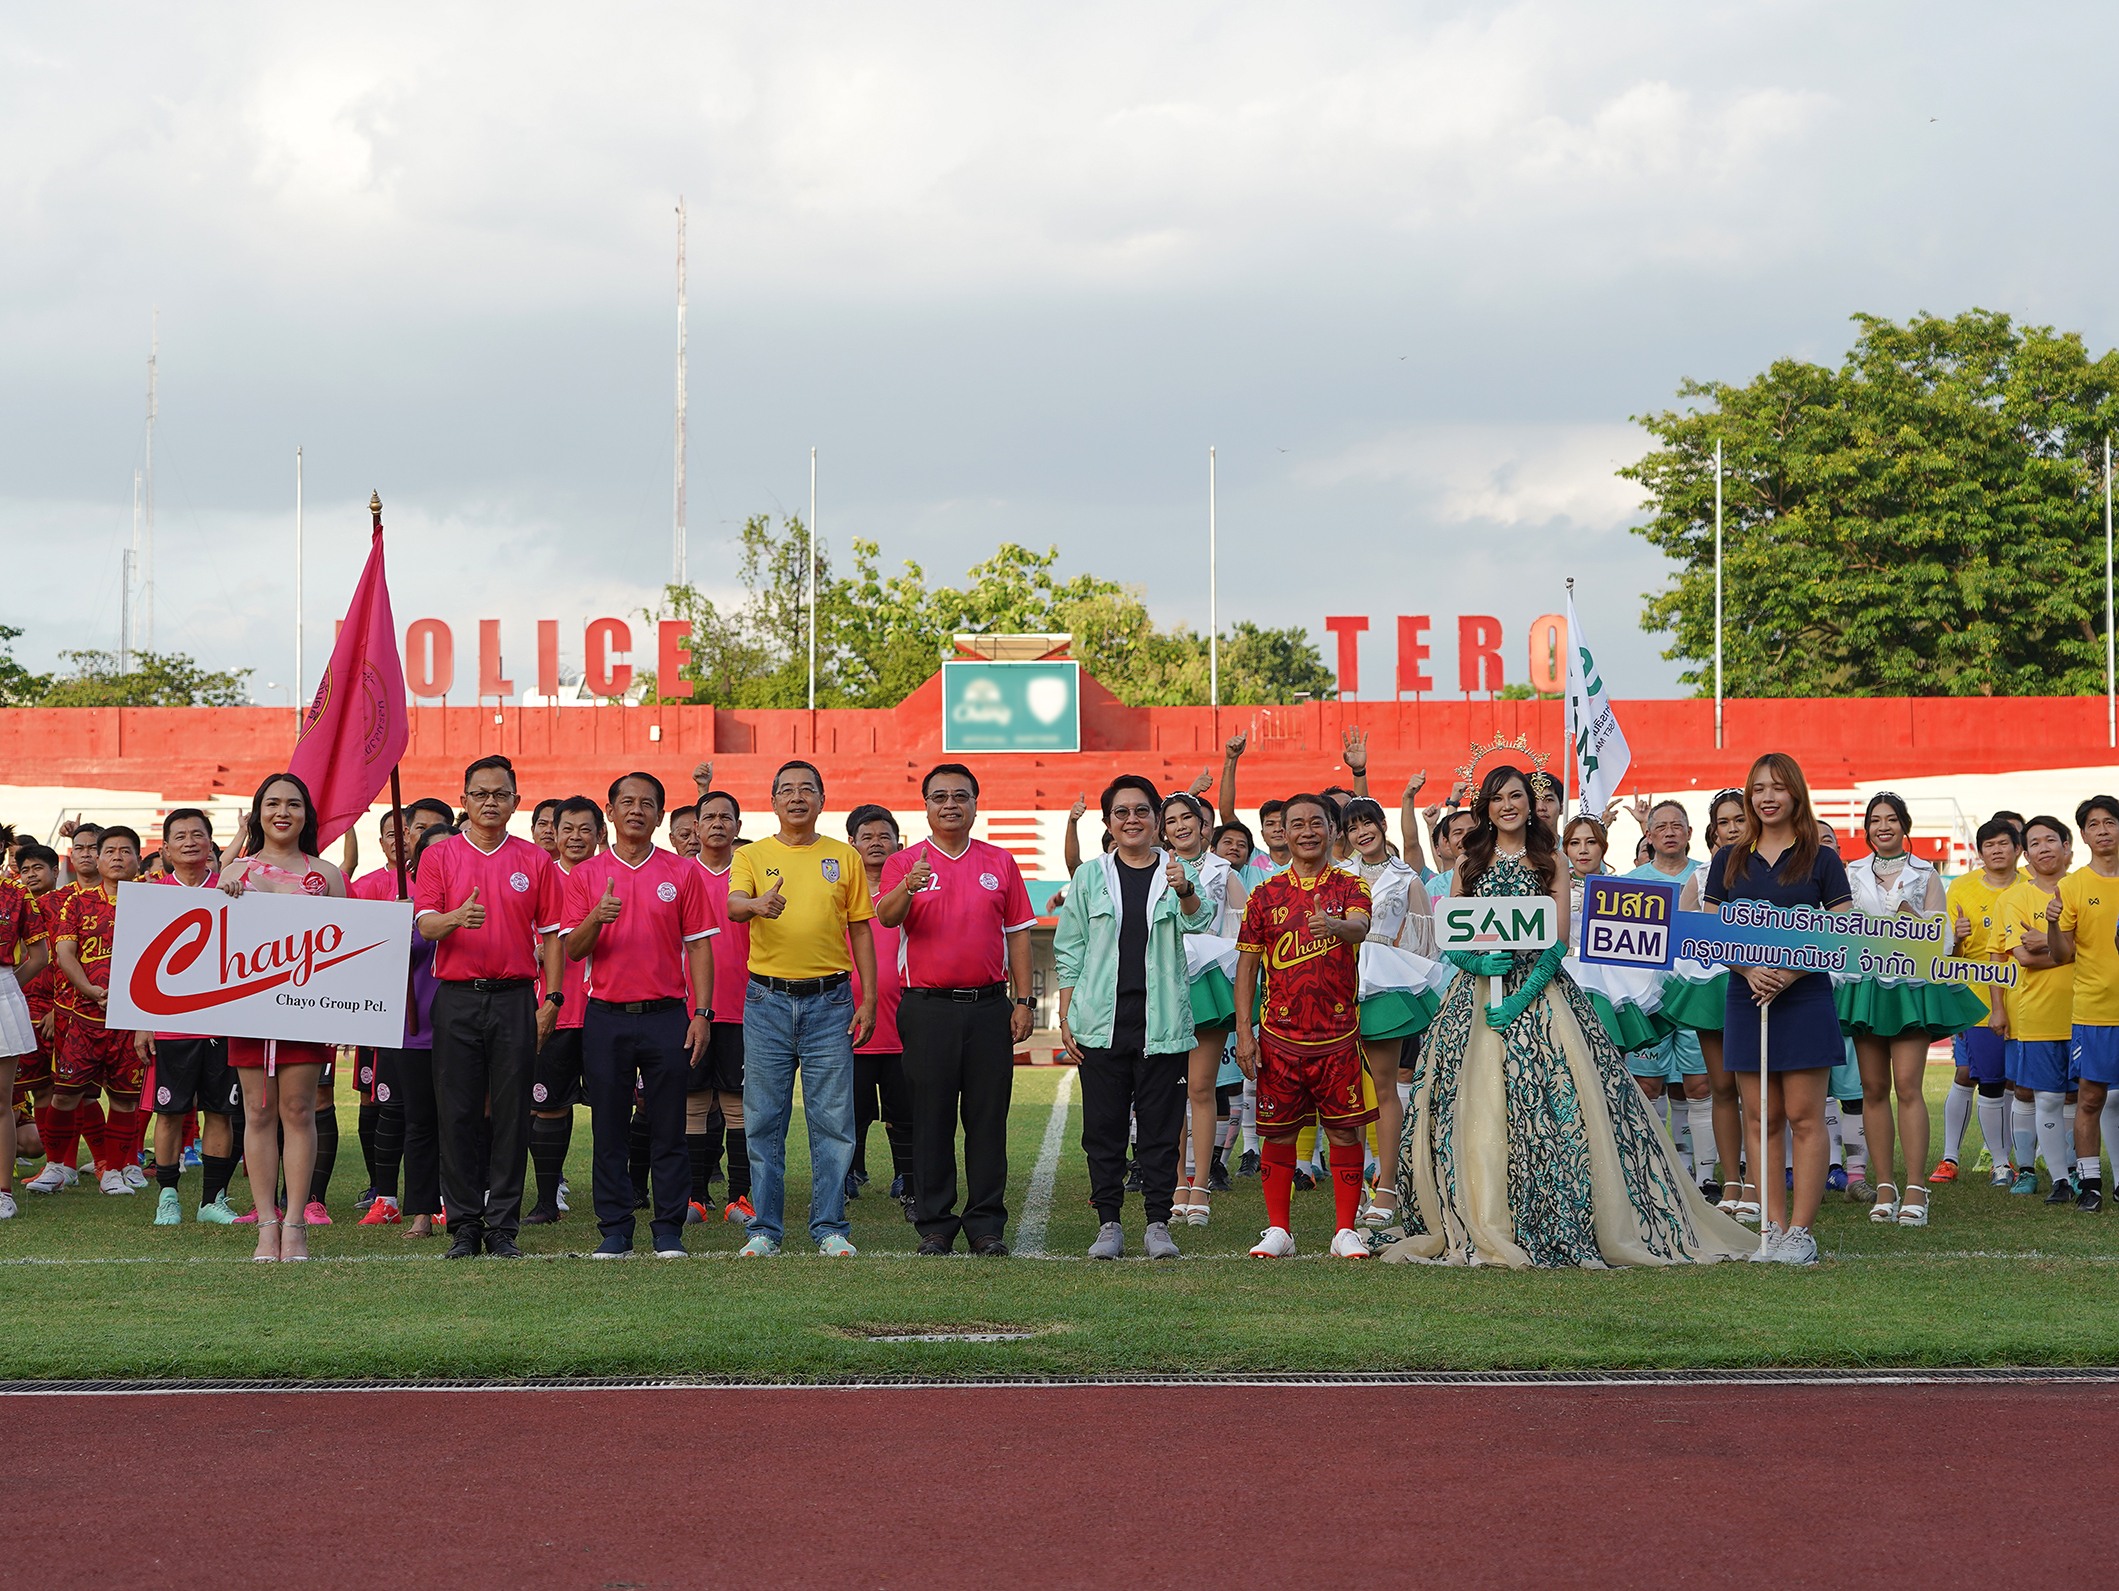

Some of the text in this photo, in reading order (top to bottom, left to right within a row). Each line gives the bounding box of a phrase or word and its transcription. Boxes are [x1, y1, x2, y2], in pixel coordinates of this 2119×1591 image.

[336, 614, 1568, 697] OLICE TERO
[1271, 906, 1289, 925] 19
[1596, 889, 1666, 921] บสก
[82, 915, 98, 930] 25
[1446, 907, 1546, 942] SAM
[1721, 902, 1943, 942] บริษัทบริหารสินทรัพย์
[1272, 929, 1344, 970] Chayo
[1593, 926, 1661, 957] BAM
[129, 904, 391, 1016] Chayo
[1681, 938, 2018, 988] กรุงเทพพาณิชย์ จำกัด (มหาชน)
[275, 993, 387, 1013] Chayo Group Pcl.
[229, 1083, 239, 1105] 6
[1346, 1085, 1358, 1104] 3
